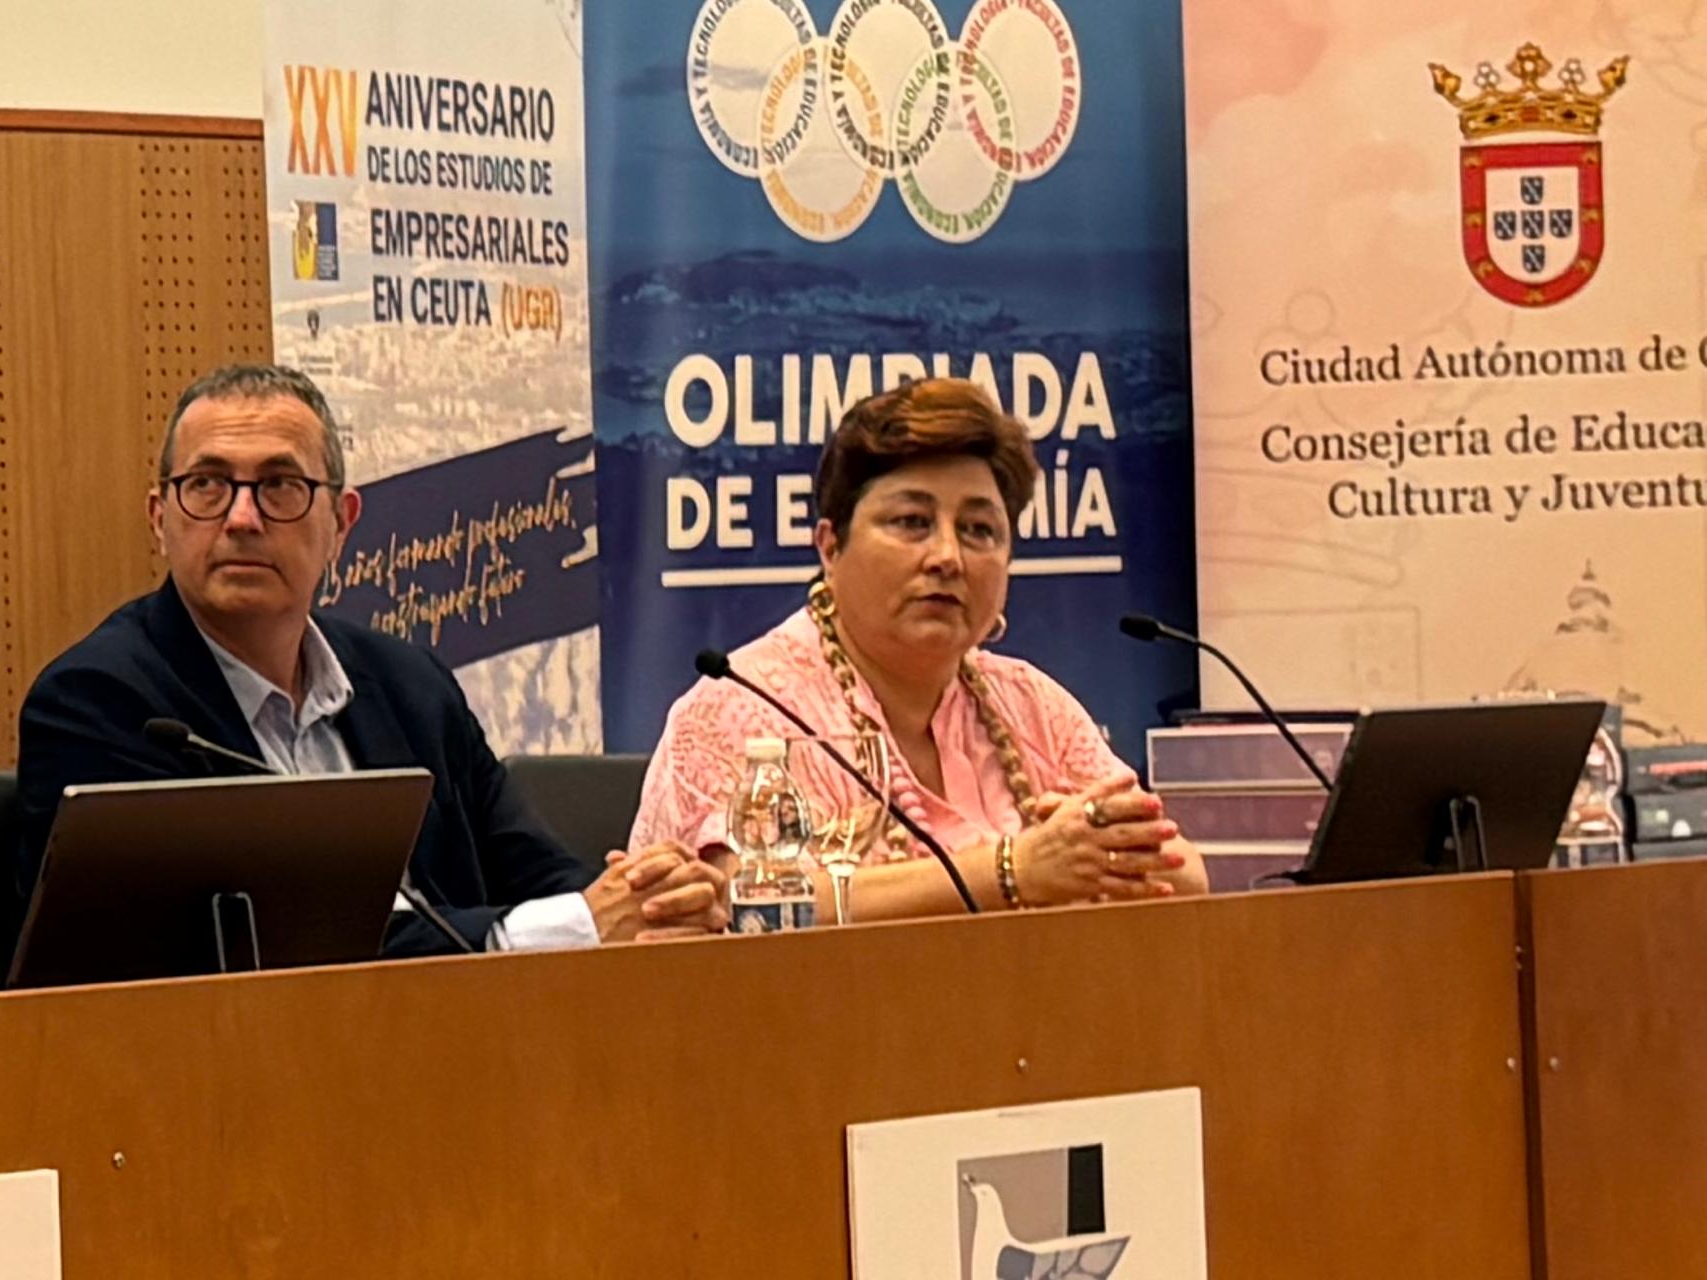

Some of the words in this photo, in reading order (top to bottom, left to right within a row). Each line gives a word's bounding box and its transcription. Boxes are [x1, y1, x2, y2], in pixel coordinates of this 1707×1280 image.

[284, 65, 357, 178] XXV
[365, 70, 555, 143] ANIVERSARIO
[367, 145, 391, 183] DE
[394, 148, 431, 187] LOS
[437, 151, 526, 194] ESTUDIOS
[530, 159, 552, 195] DE
[370, 208, 569, 267] EMPRESARIALES
[373, 275, 402, 323] EN
[410, 277, 491, 327] CEUTA
[501, 282, 563, 342] (UGR)
[1260, 344, 1402, 386] Ciudad
[1414, 340, 1627, 379] Autónoma
[1638, 334, 1689, 371] de
[664, 352, 1117, 448] OLIMDA
[1261, 416, 1491, 469] Consejería
[1504, 413, 1558, 455] de
[1572, 410, 1706, 452] Educa
[666, 475, 754, 550] DE
[777, 449, 1117, 547] EMÍA
[1328, 477, 1493, 519] Cultura
[1503, 483, 1531, 522] y
